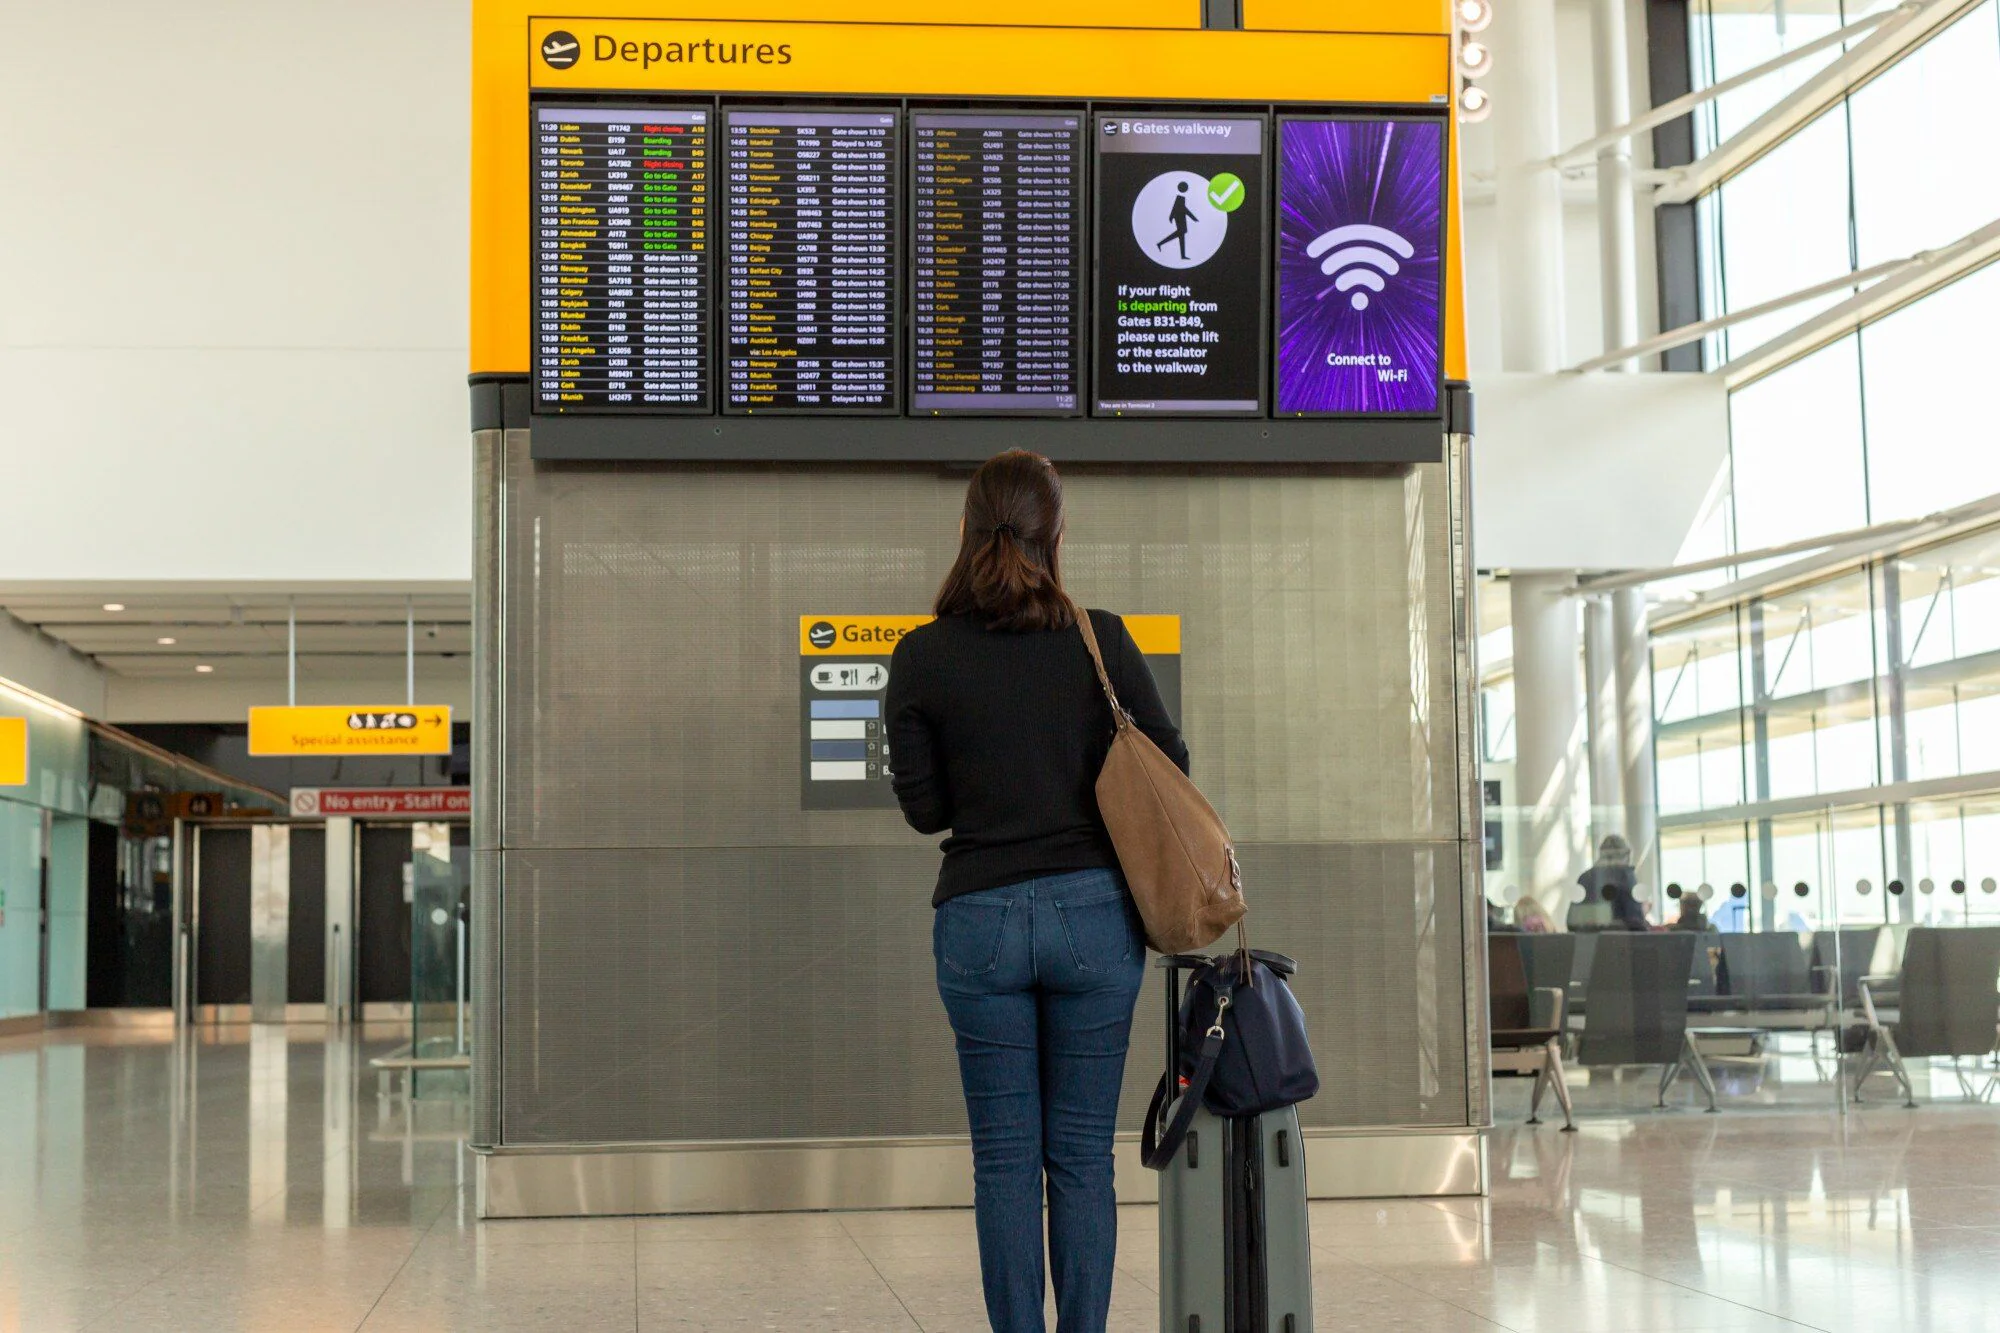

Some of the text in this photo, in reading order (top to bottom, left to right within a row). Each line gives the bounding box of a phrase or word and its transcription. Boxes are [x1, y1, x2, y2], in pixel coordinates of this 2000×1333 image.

[594, 34, 792, 69] Departures
[644, 126, 661, 134] Flight
[663, 126, 684, 134] closing
[1121, 122, 1232, 137] B Gates walkway
[644, 137, 672, 146] Boarding
[832, 140, 857, 148] Delayed
[644, 149, 672, 157] Boarding
[644, 161, 661, 169] Flight
[663, 161, 684, 169] closing
[560, 265, 588, 273] Newquay
[1118, 285, 1191, 298] If your flight
[1118, 301, 1218, 313] is departing from
[1118, 316, 1204, 328] Gates B31-B49,
[1118, 331, 1219, 344] please use the lift
[572, 347, 595, 355] Angeles
[1117, 347, 1207, 358] or the escalator
[1327, 353, 1391, 365] Connect to
[560, 370, 580, 378] Lisbon
[1117, 362, 1207, 375] to the walkway
[1378, 369, 1408, 381] Wi-Fi
[561, 382, 575, 390] Cork
[843, 624, 907, 642] Gates
[292, 735, 418, 747] Special assistance
[325, 795, 348, 808] No
